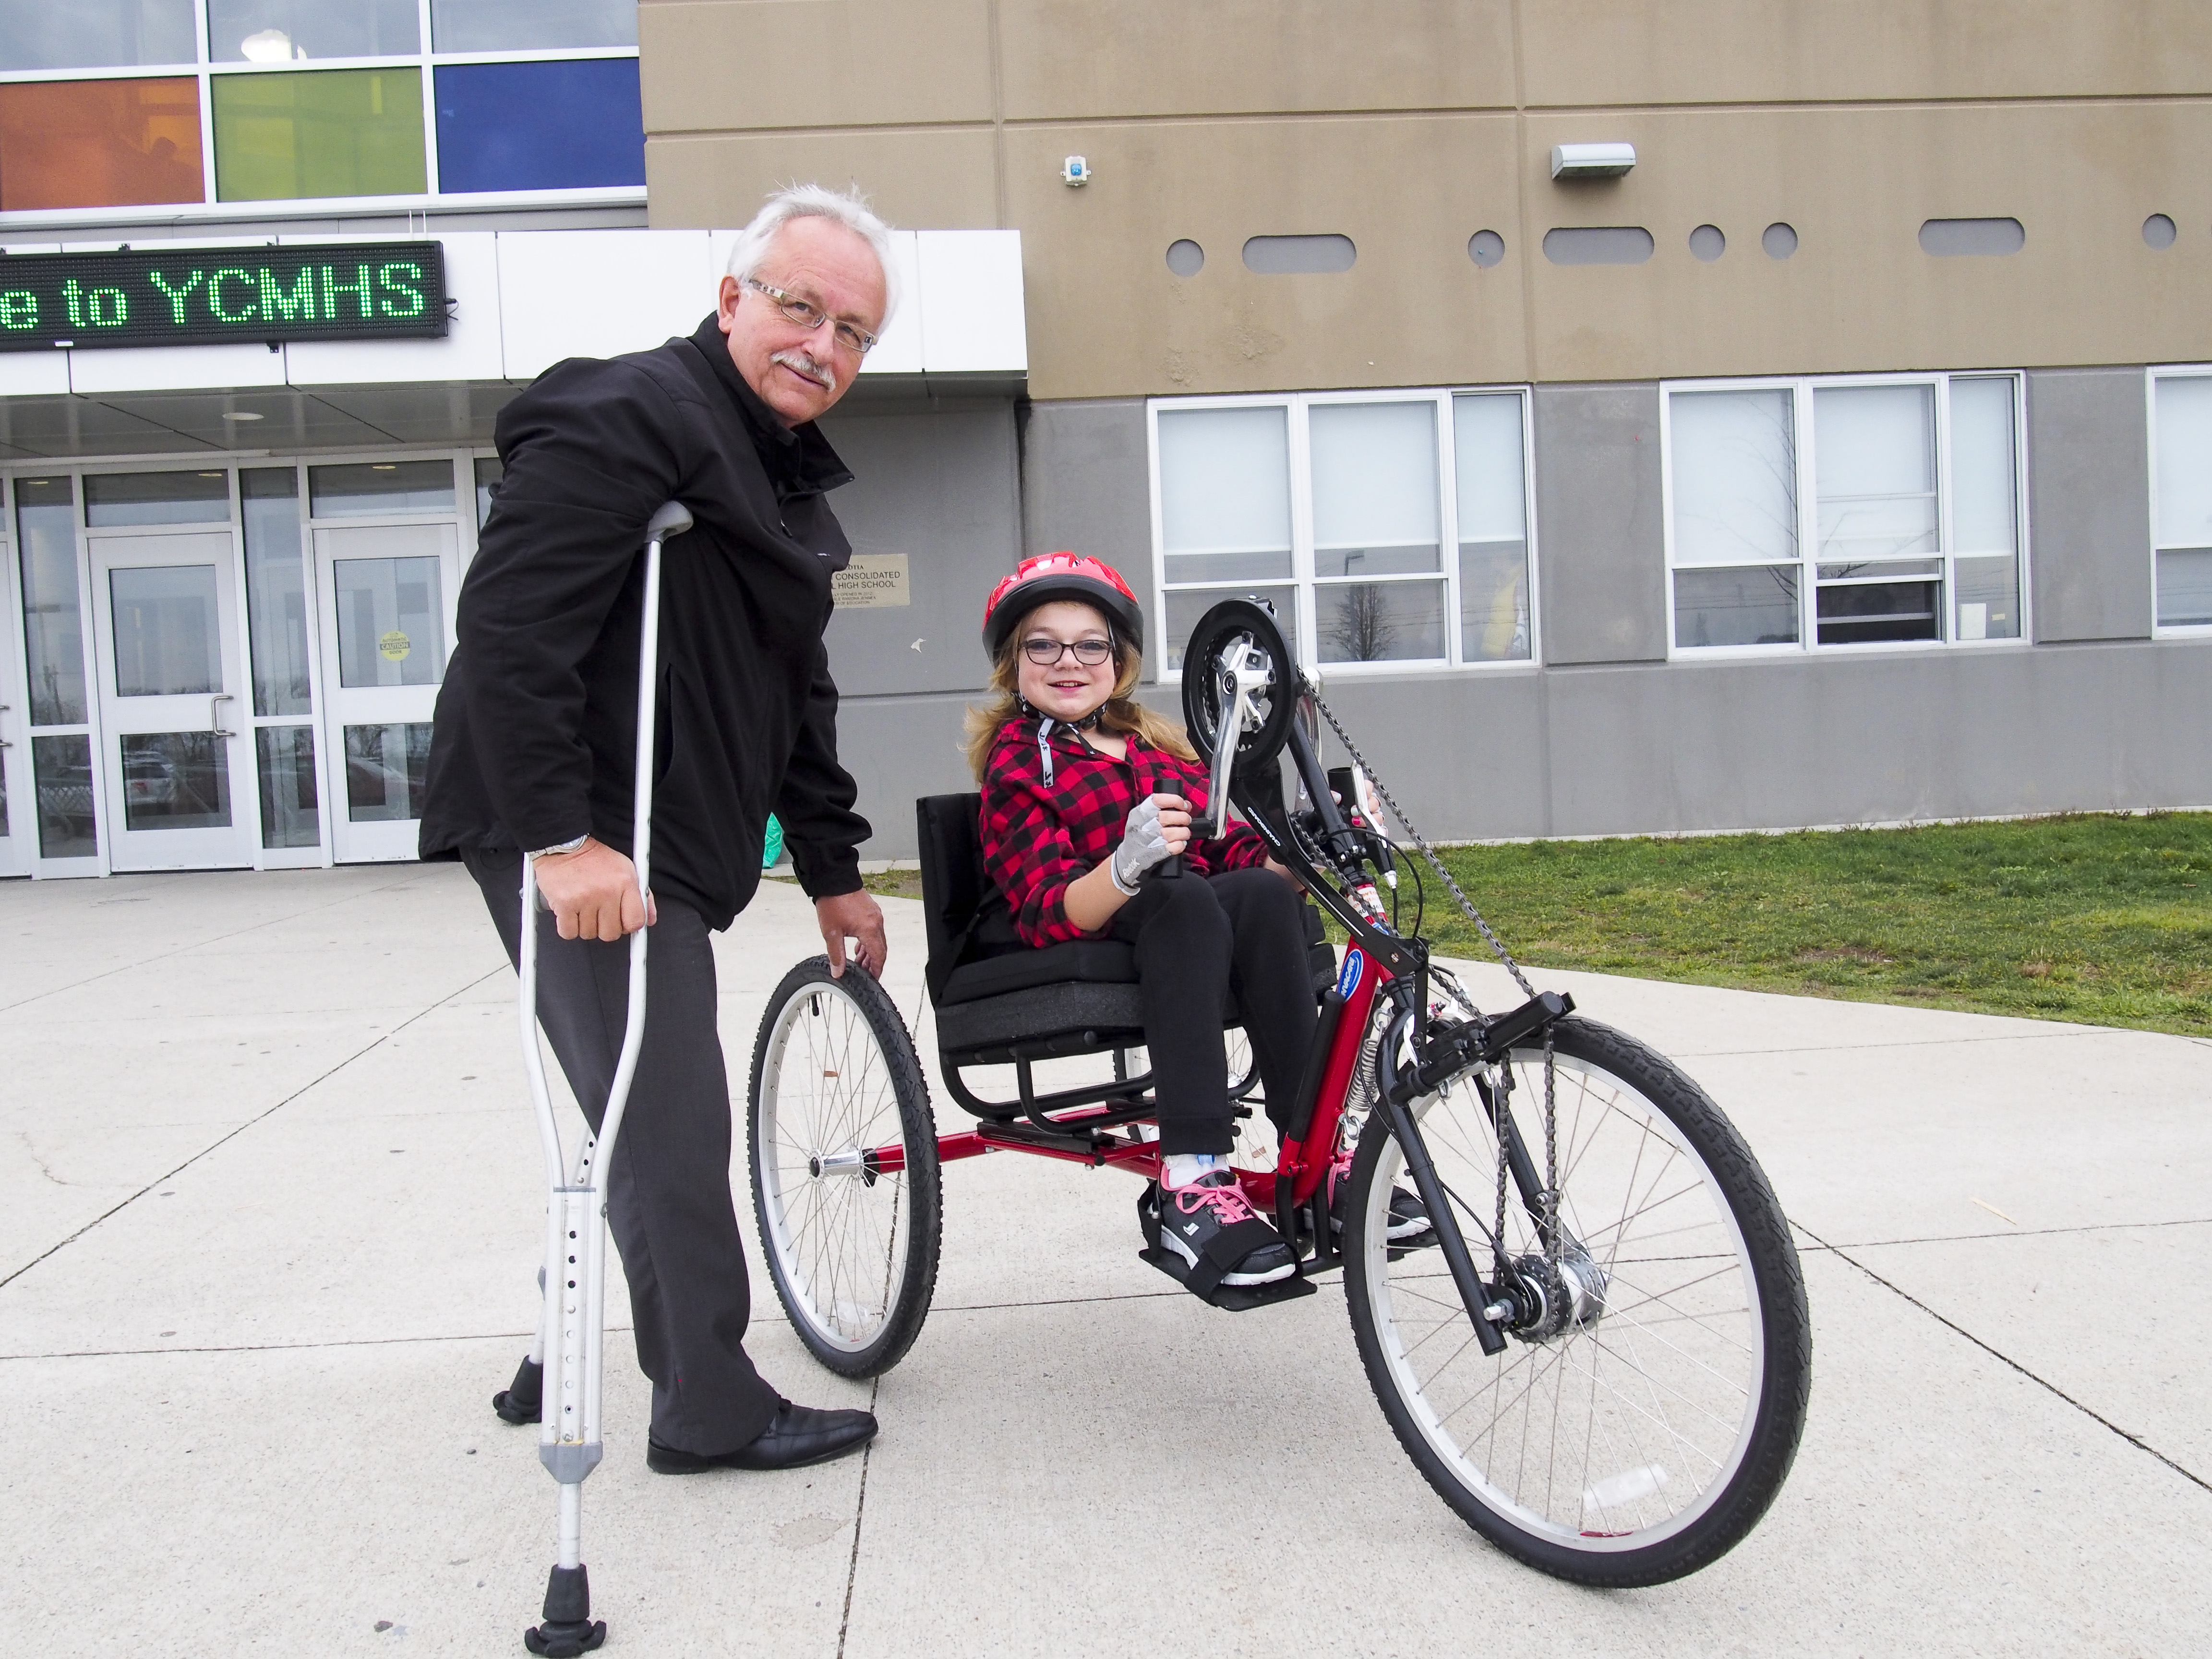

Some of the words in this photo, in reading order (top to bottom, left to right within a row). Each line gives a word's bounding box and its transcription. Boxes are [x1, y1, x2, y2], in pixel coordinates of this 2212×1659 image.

[62, 279, 127, 327] to
[150, 263, 424, 325] YCMHS
[835, 571, 901, 581] CONSOLIDATED
[838, 581, 858, 589] HIGH
[861, 580, 896, 589] SCHOOL
[1340, 956, 1357, 998] NVACARE
